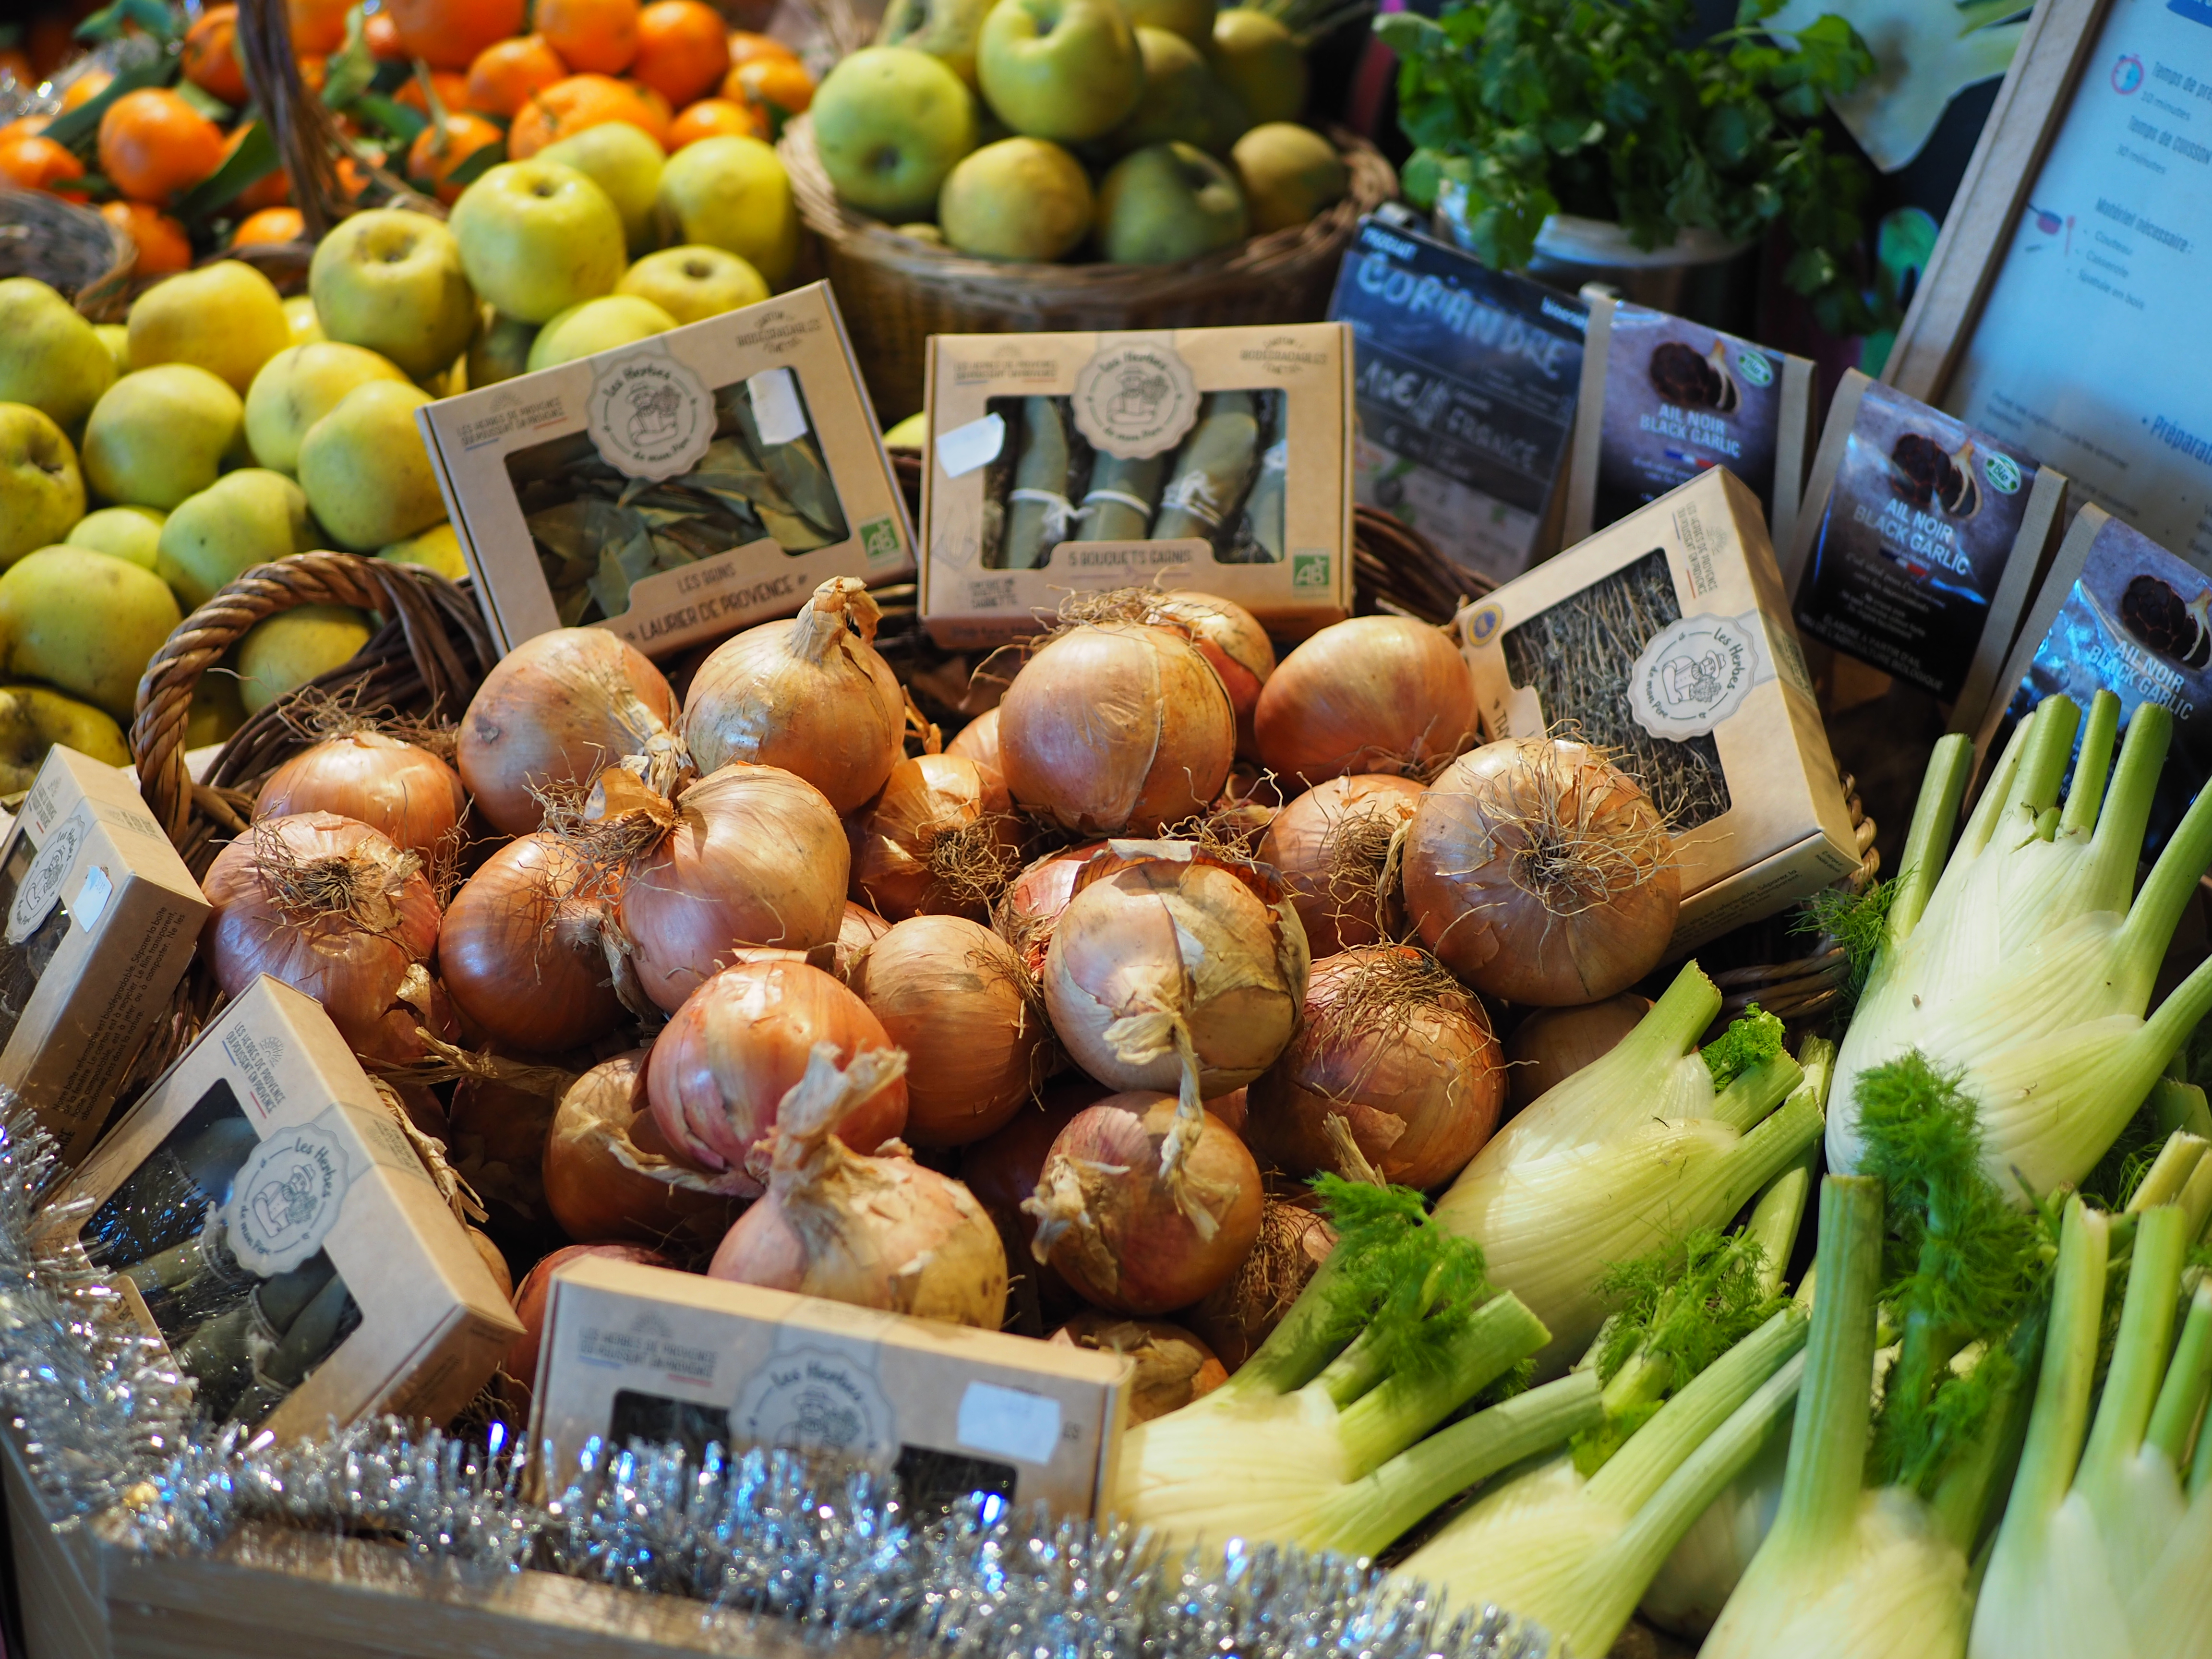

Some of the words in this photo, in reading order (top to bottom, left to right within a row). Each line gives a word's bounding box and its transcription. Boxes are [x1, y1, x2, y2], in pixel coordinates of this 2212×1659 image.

[1352, 247, 1573, 382] CORIANDRE
[1637, 412, 1690, 442] BLACK
[1688, 427, 1743, 460] GARLIC
[1658, 402, 1685, 423] AIL
[1684, 409, 1729, 436] NOIR
[1993, 462, 2010, 482] Bio
[1883, 496, 1915, 523] AIL
[1910, 510, 1956, 544] NOIR
[1696, 542, 1707, 553] DE
[1851, 504, 1910, 545] BLACK
[1907, 530, 1972, 577] GARLIC
[1068, 552, 1077, 566] 5
[1080, 550, 1146, 565] BOUQUETS
[1149, 550, 1192, 565] GARNIS
[1700, 553, 1718, 591] PROVENCE
[1690, 562, 1708, 596] PROVENCE
[638, 605, 699, 641] LAURIER
[697, 599, 721, 622] DE
[719, 573, 795, 614] PROVENCE
[1648, 666, 1658, 677] de
[1713, 627, 1731, 646] Les
[1727, 643, 1745, 688] Herbes
[2112, 638, 2144, 668] AIL
[2140, 655, 2187, 694] NOIR
[1646, 680, 1654, 703] mon
[2086, 644, 2140, 686] BLACK
[2137, 675, 2194, 721] GARLIC
[146, 924, 157, 935] la
[151, 905, 167, 926] boîte
[131, 932, 152, 964] Séparer
[87, 1055, 97, 1065] Le
[94, 1030, 111, 1056] carton
[107, 1018, 118, 1030] est
[134, 968, 144, 979] Le
[139, 953, 152, 969] film
[147, 909, 178, 954] transparent,
[100, 962, 138, 1021] biodégradable.
[110, 1032, 121, 1044] est
[122, 1003, 136, 1022] jeter
[132, 992, 143, 1002] ou
[144, 940, 171, 983] composter.
[166, 926, 178, 939] Ne
[174, 912, 186, 926] les
[95, 1019, 106, 1032] est
[111, 1042, 126, 1062] dans
[120, 1034, 130, 1044] la
[127, 1008, 145, 1034] nature.
[224, 1030, 238, 1045] QUI
[232, 1021, 247, 1037] LES
[73, 1029, 100, 1071] refermable
[229, 1040, 254, 1074] POUSSENT
[240, 1034, 261, 1061] HERBES
[253, 1057, 267, 1071] DE
[247, 1070, 260, 1083] EN
[259, 1068, 287, 1105] PROVENCE
[51, 1088, 67, 1112] Notre
[251, 1079, 278, 1114] PROVENCE
[295, 1137, 313, 1154] Les
[314, 1146, 337, 1197] Herbes
[241, 1205, 248, 1218] de
[241, 1222, 253, 1246] mon
